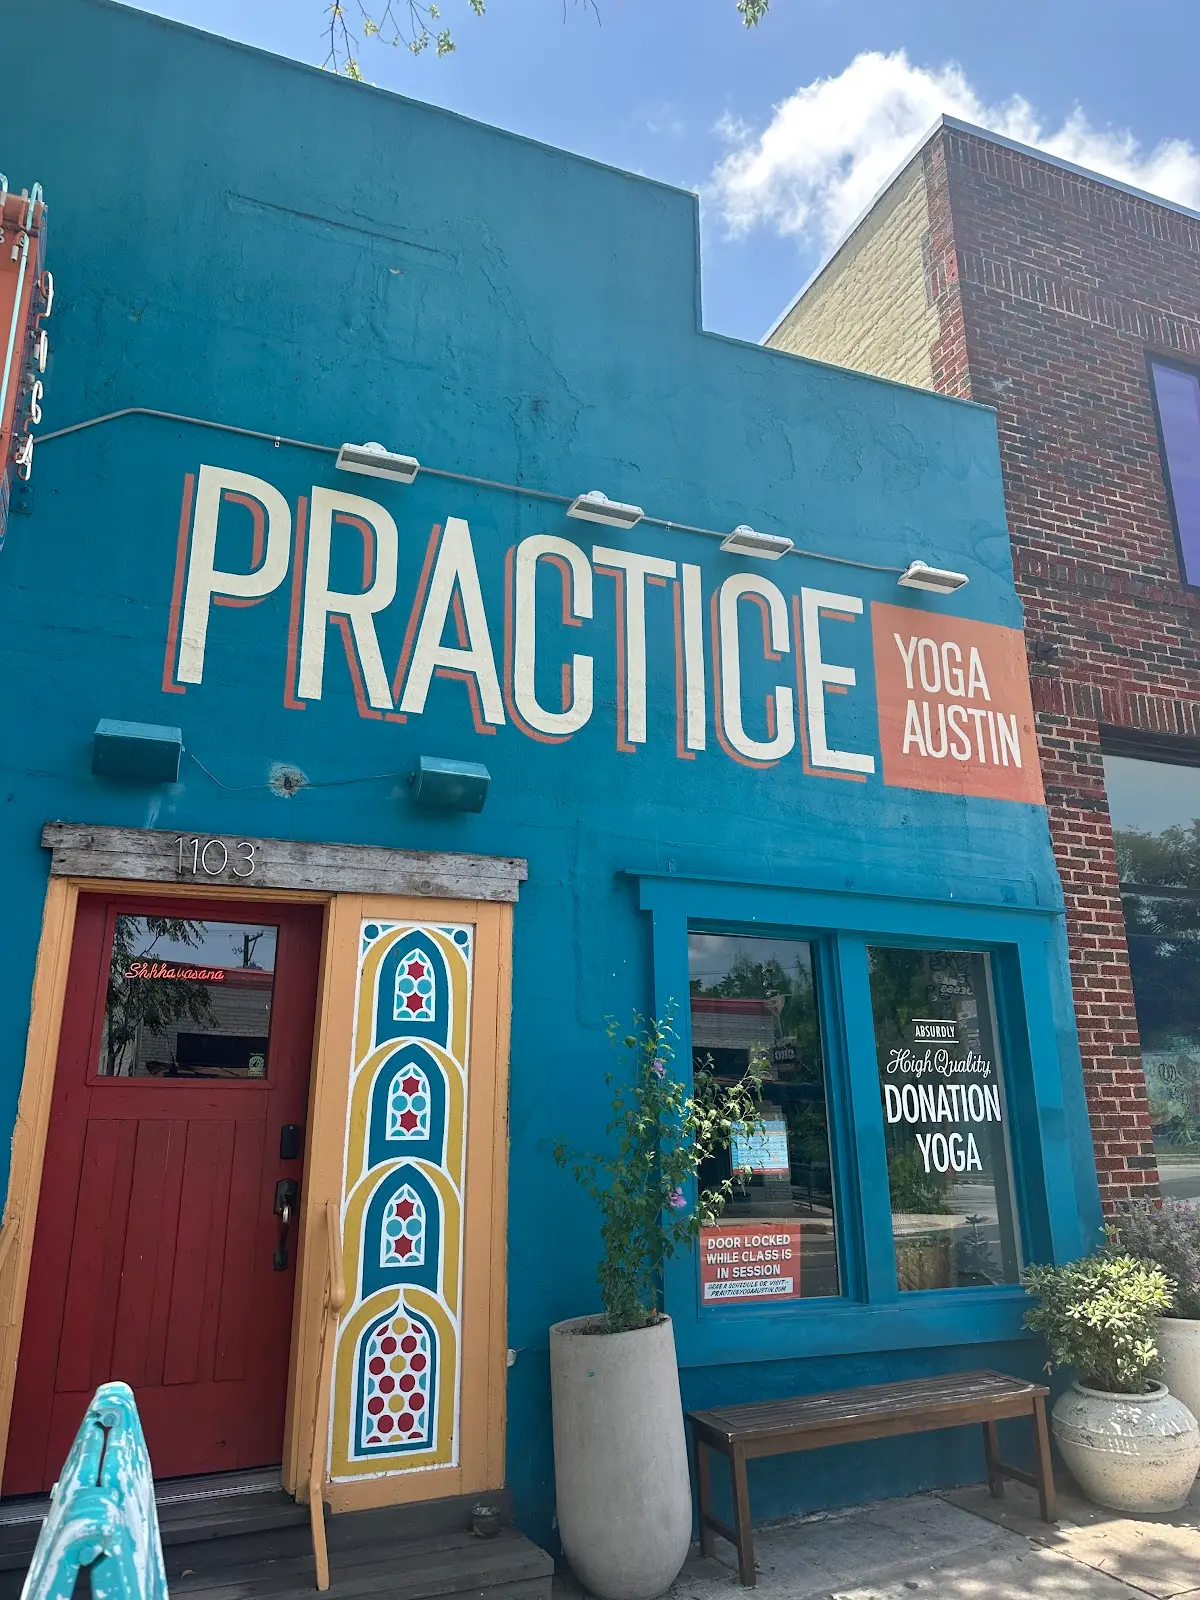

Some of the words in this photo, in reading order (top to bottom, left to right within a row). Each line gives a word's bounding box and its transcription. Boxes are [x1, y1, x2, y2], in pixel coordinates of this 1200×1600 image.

[176, 463, 875, 775] PRACTICE
[893, 632, 992, 702] YOGA
[902, 699, 1023, 769] AUSTIN
[174, 837, 256, 878] 1103
[915, 1025, 956, 1038] ABSURDLY
[886, 1048, 934, 1079] High
[934, 1048, 992, 1079] Quality
[883, 1083, 1002, 1124] DONATION
[915, 1132, 984, 1173] YOGA
[706, 1251, 739, 1265] WHILE
[741, 1249, 779, 1263] CLASS
[781, 1248, 792, 1260] IS
[707, 1236, 741, 1250] DOOR
[744, 1234, 791, 1248] LOCKED
[717, 1267, 729, 1279] IN
[732, 1264, 781, 1278] SESSION
[728, 1281, 758, 1289] SCHEDULE
